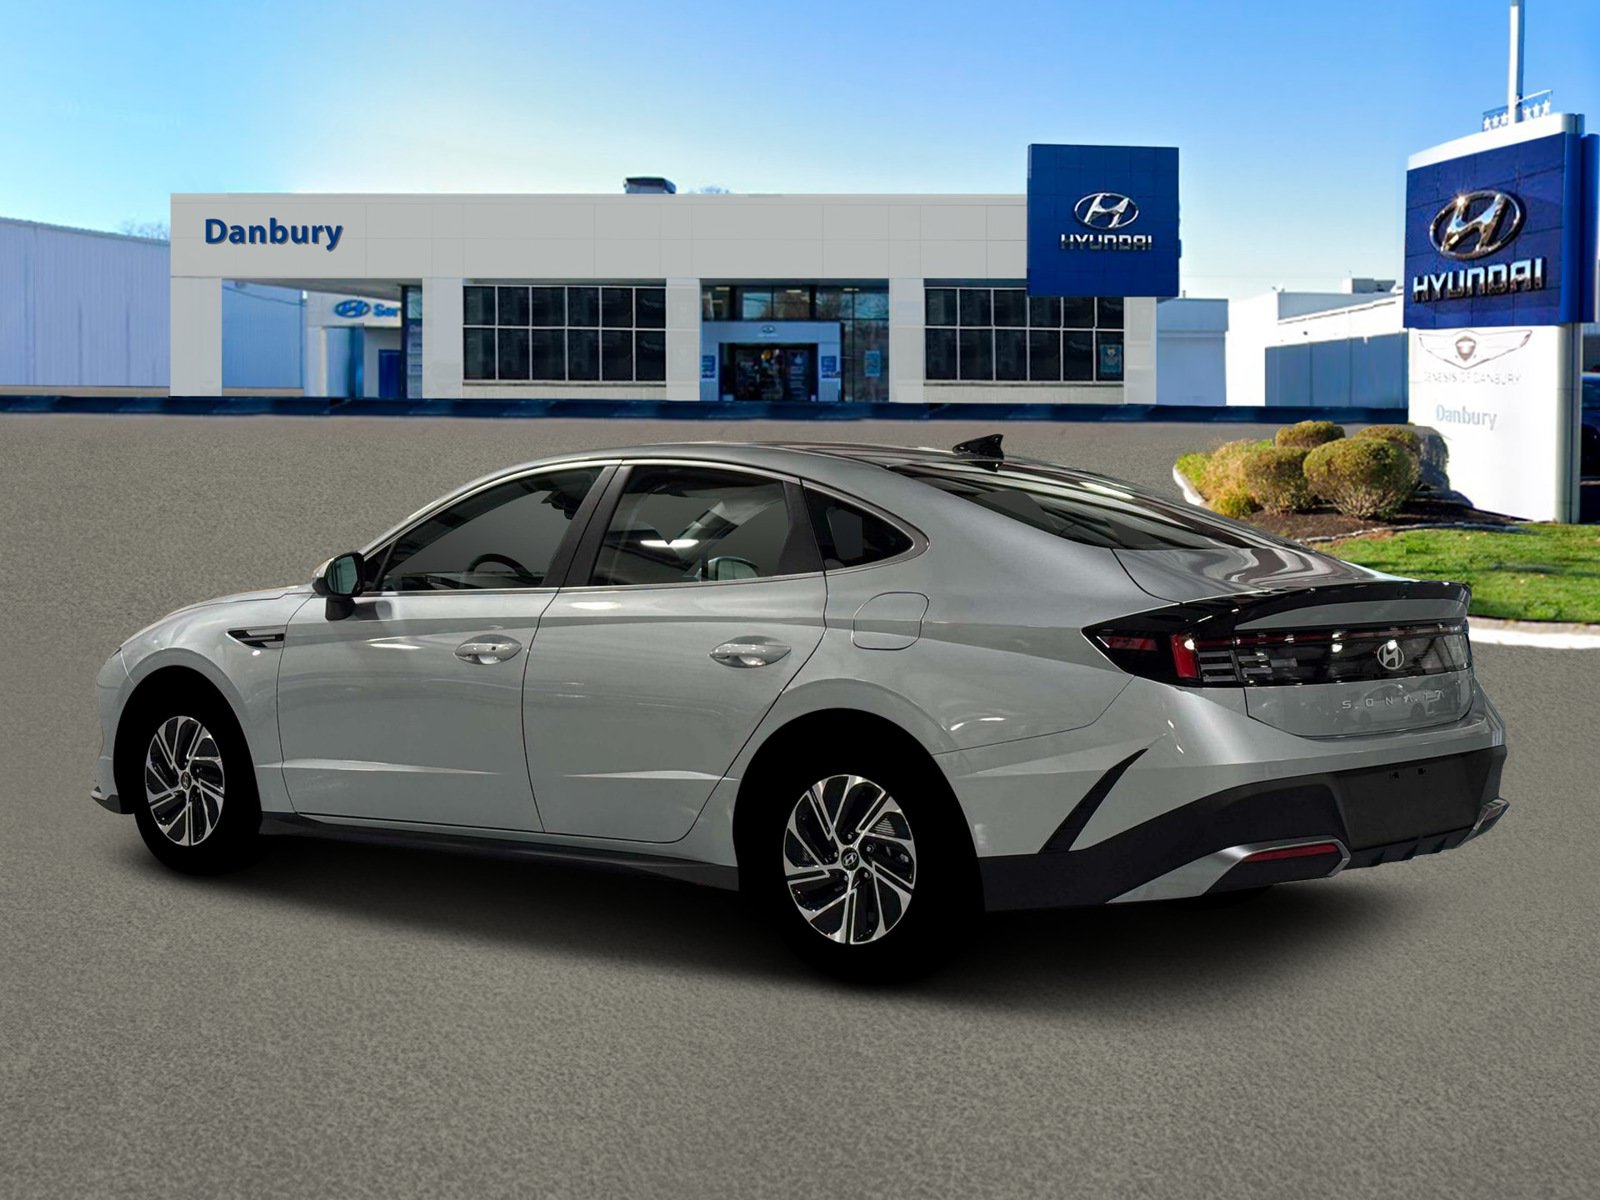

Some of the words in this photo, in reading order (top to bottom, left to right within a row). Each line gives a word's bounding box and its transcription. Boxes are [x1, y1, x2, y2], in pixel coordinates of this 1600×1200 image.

[205, 217, 343, 251] Danbury
[1060, 234, 1153, 250] HYUNDAI
[1413, 258, 1545, 303] HYUNDAI
[1436, 403, 1497, 430] Danbury
